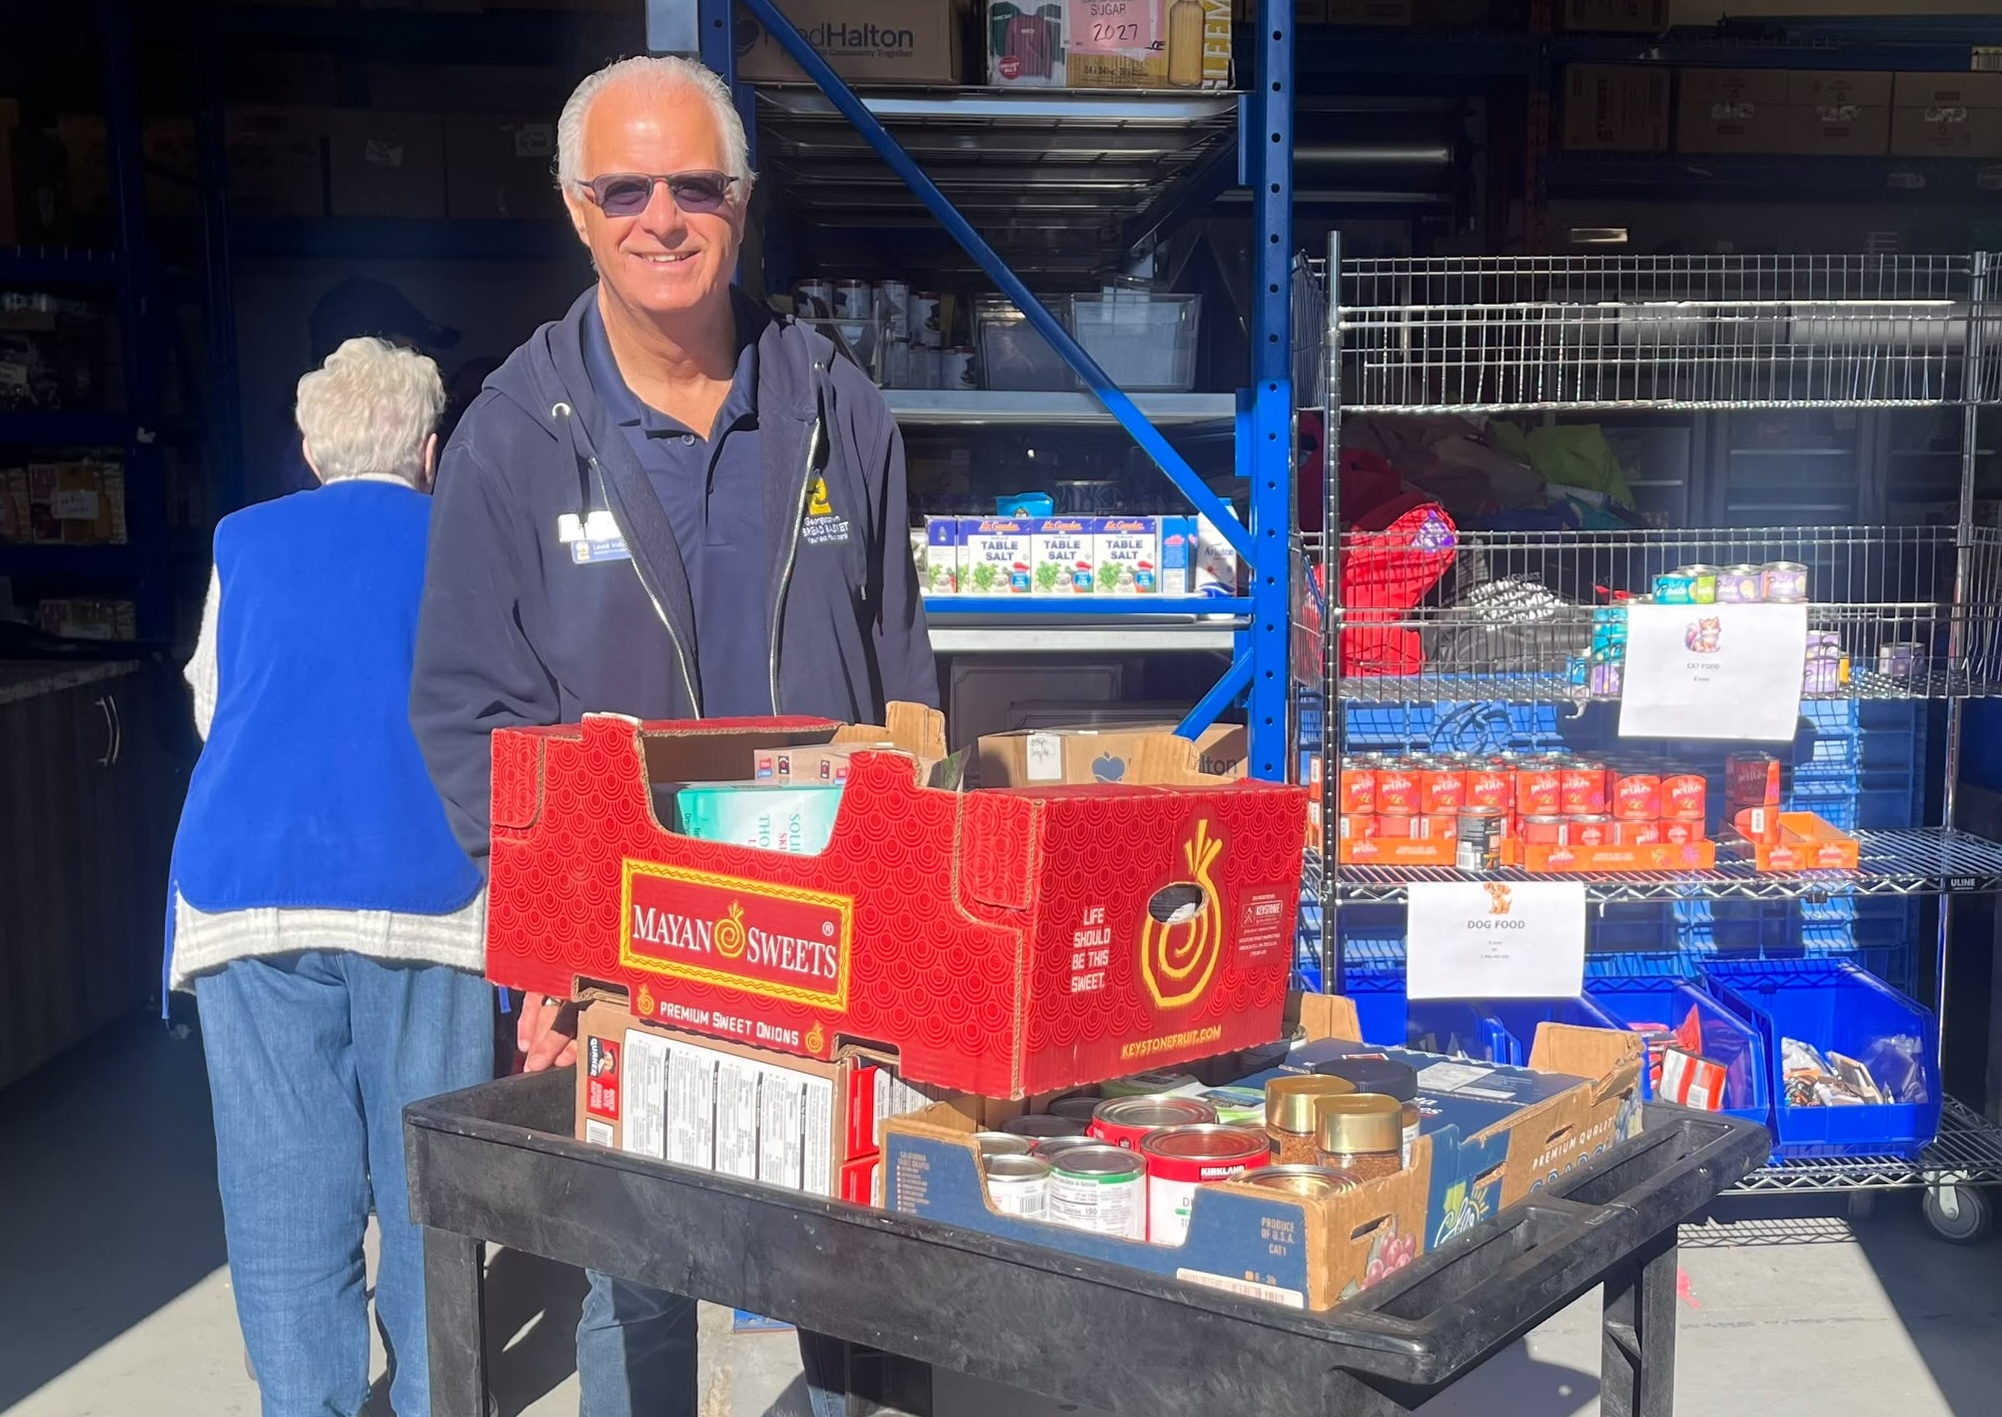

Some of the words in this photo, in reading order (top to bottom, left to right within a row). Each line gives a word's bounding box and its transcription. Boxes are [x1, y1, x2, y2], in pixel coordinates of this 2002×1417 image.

[1090, 3, 1126, 16] SUGAR
[1094, 23, 1138, 41] 2027
[981, 541, 1018, 550] TABLE
[1043, 540, 1081, 549] TABLE
[1106, 540, 1143, 549] TABLE
[986, 552, 1014, 561] SALT
[1048, 551, 1077, 560] SALT
[1110, 551, 1139, 560] SALT
[1951, 878, 1975, 887] ULINE
[1083, 907, 1105, 926] LIFE
[1467, 920, 1491, 929] DOG
[1495, 920, 1526, 929] FOOD
[633, 904, 713, 953] MAYAN
[746, 926, 837, 980] SWEETS
[1073, 927, 1111, 948] SHOULD
[1072, 953, 1086, 970] BE
[1088, 949, 1109, 968] THIS
[1071, 972, 1105, 993] SWEET.
[660, 1001, 709, 1026] PREMIUM
[713, 1011, 752, 1036] SWEET
[756, 1021, 799, 1047] ONIONS
[1121, 1024, 1222, 1059] KEYSTONEFRUIT.COM
[589, 1037, 599, 1077] QUAKER
[1532, 1138, 1576, 1171] PREMIUM
[1579, 1115, 1617, 1145] QUALIT
[1200, 1165, 1246, 1177] KIRKLAND
[1261, 1217, 1295, 1232] PRODUCE
[1261, 1228, 1271, 1239] OF
[1272, 1231, 1295, 1244] U.S.A.
